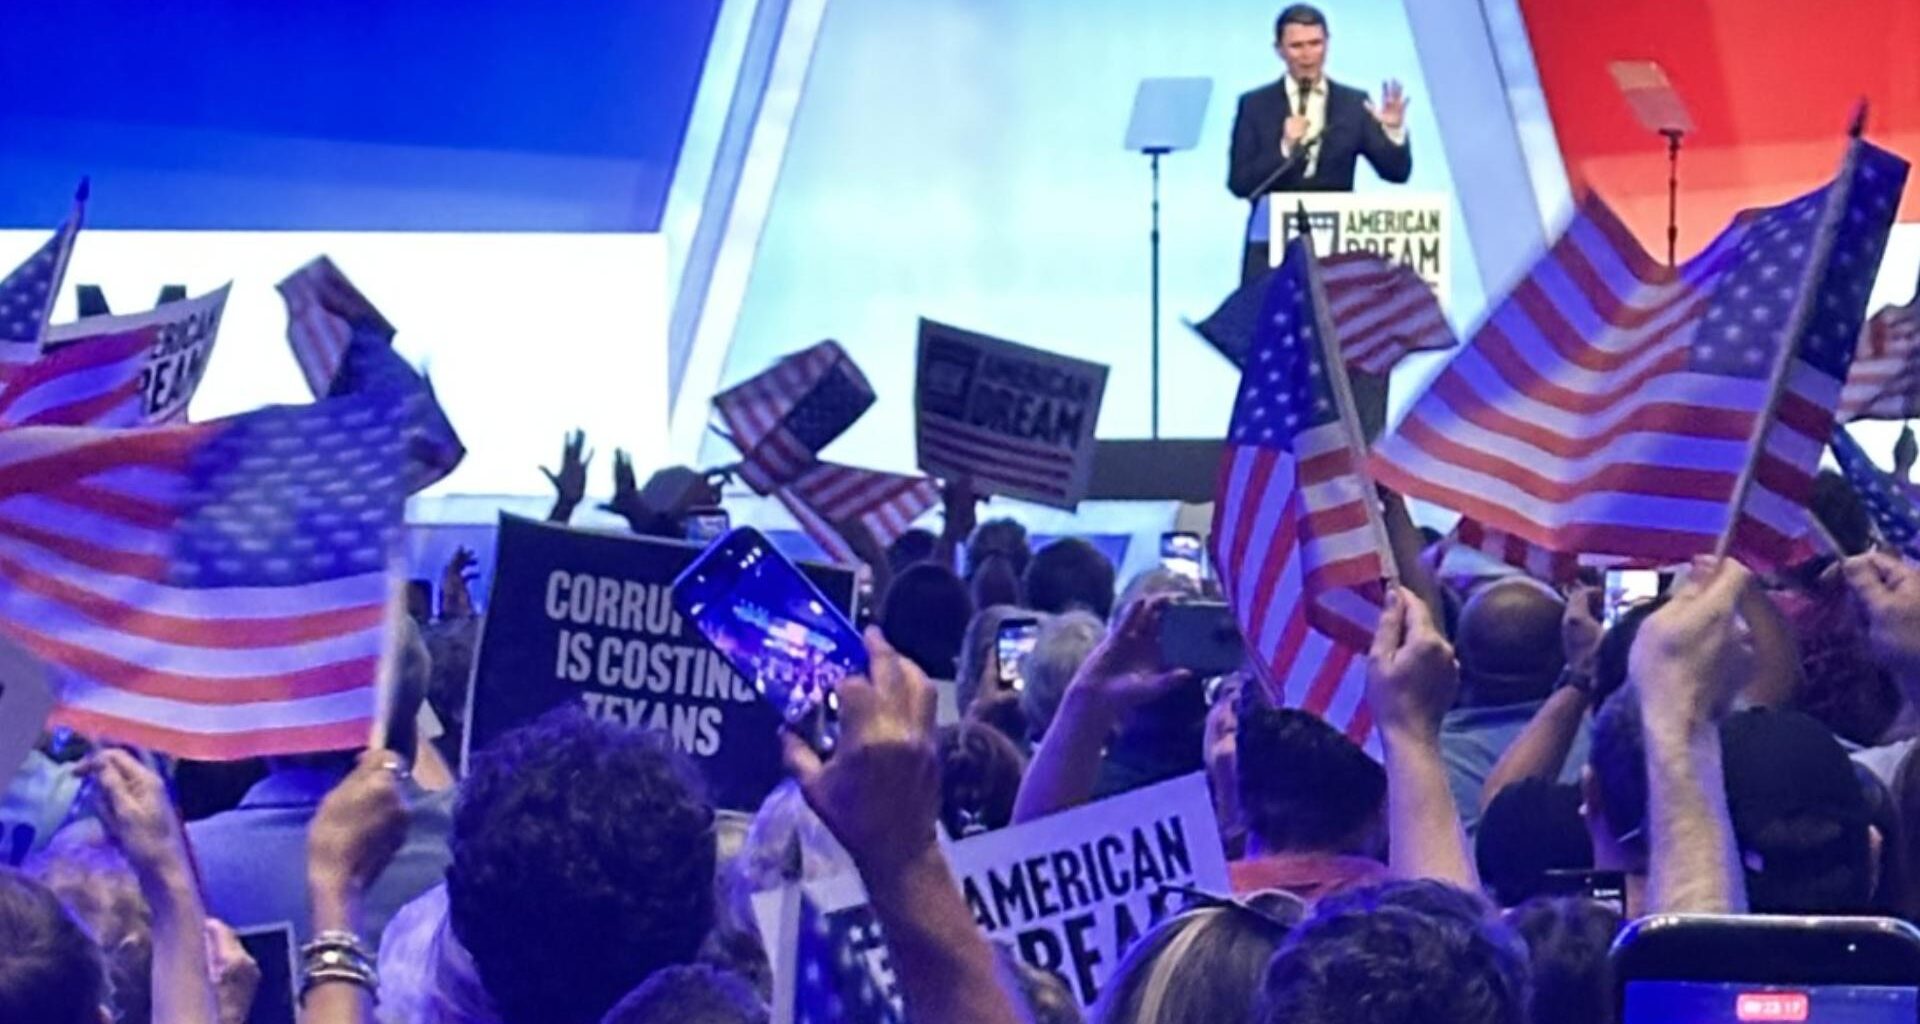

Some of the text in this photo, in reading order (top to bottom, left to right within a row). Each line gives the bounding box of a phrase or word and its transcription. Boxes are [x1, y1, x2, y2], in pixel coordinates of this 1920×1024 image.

[1345, 209, 1440, 234] AMERICAN
[969, 382, 1085, 450] DREAM
[555, 629, 593, 682] IS
[581, 691, 723, 757] TEXANS
[962, 815, 1193, 932] AMERICAN
